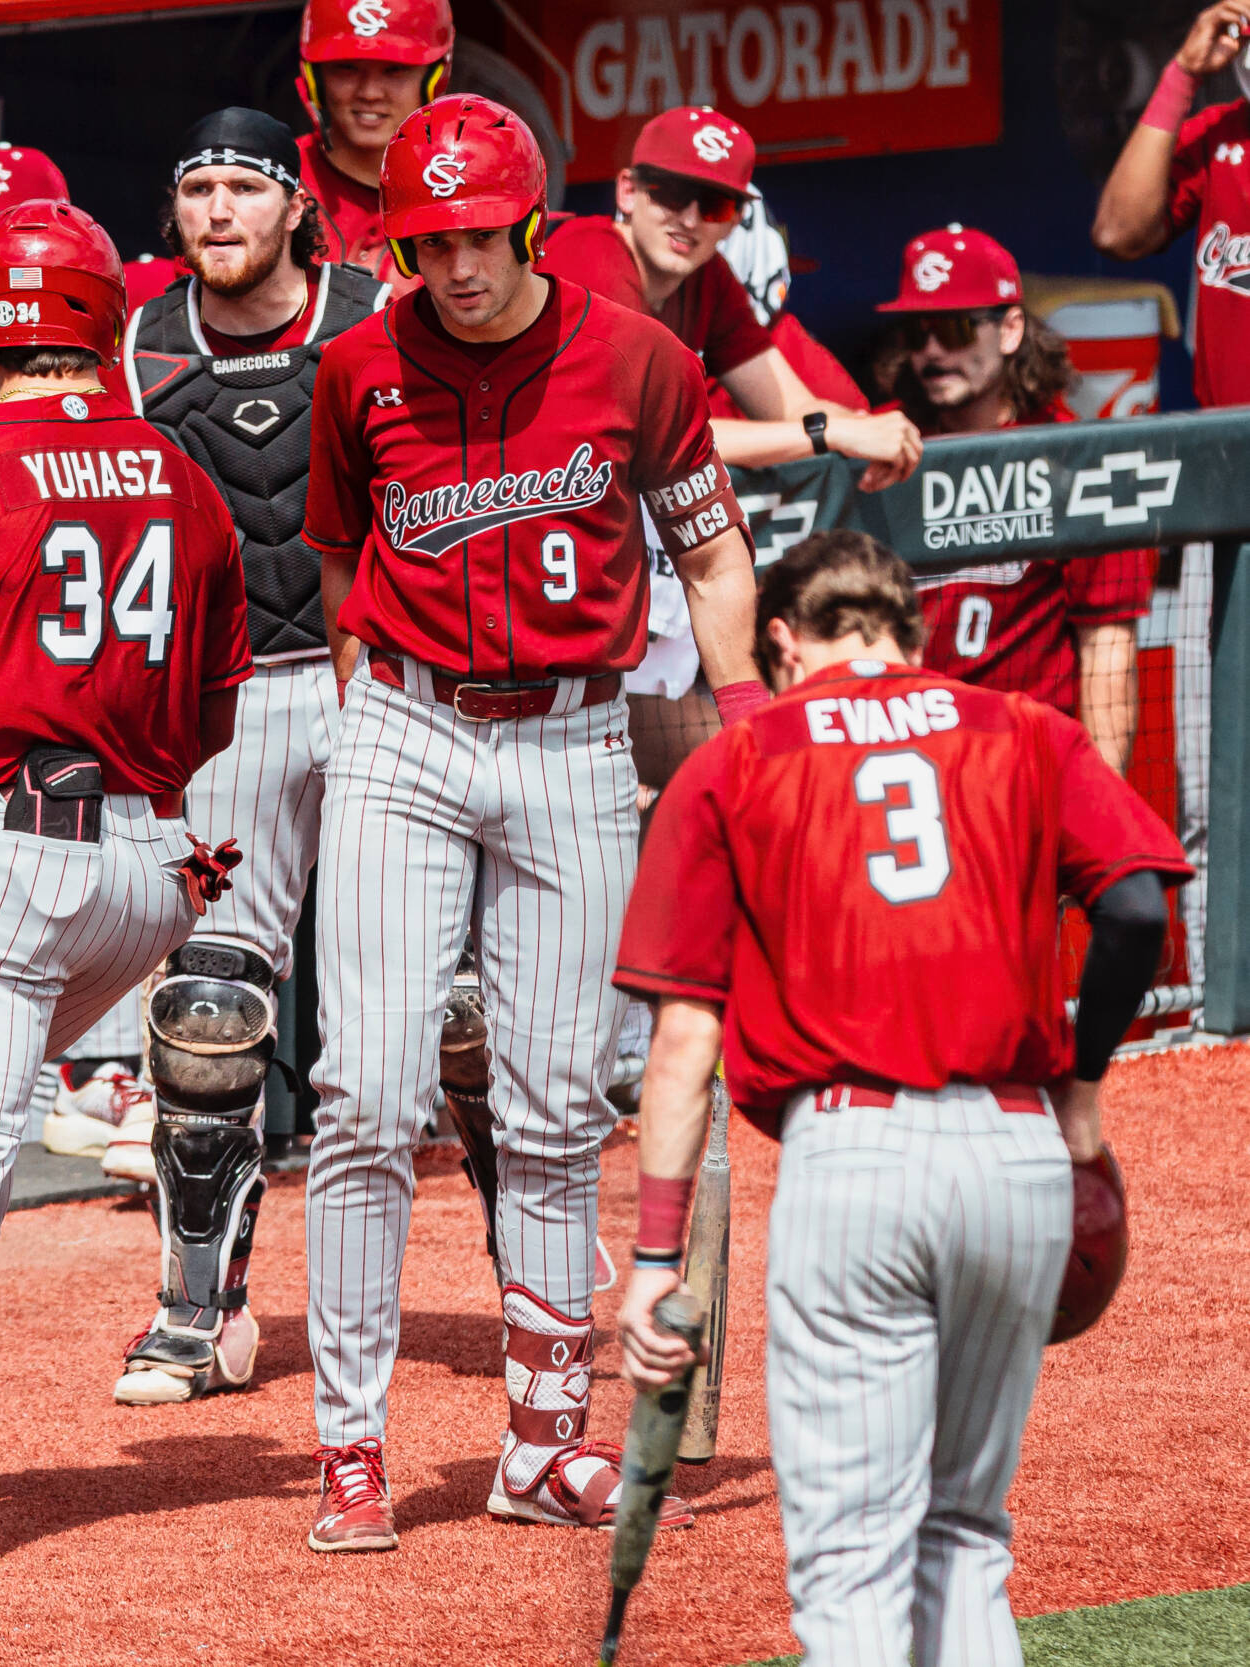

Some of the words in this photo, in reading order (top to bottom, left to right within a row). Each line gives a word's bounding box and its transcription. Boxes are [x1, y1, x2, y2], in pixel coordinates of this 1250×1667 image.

[573, 0, 971, 120] GATORADE
[16, 301, 41, 324] 34
[212, 352, 291, 374] GAMECOCKS
[20, 449, 172, 500] YUHASZ
[383, 443, 613, 549] Gamecocks
[647, 463, 718, 514] PFORP
[922, 457, 1052, 521] DAVIS
[671, 502, 729, 548] WC9
[923, 514, 1054, 550] GAINESVILLE
[37, 518, 177, 669] 34
[541, 529, 578, 604] 9
[804, 688, 960, 745] EVANS
[854, 751, 951, 900] 3
